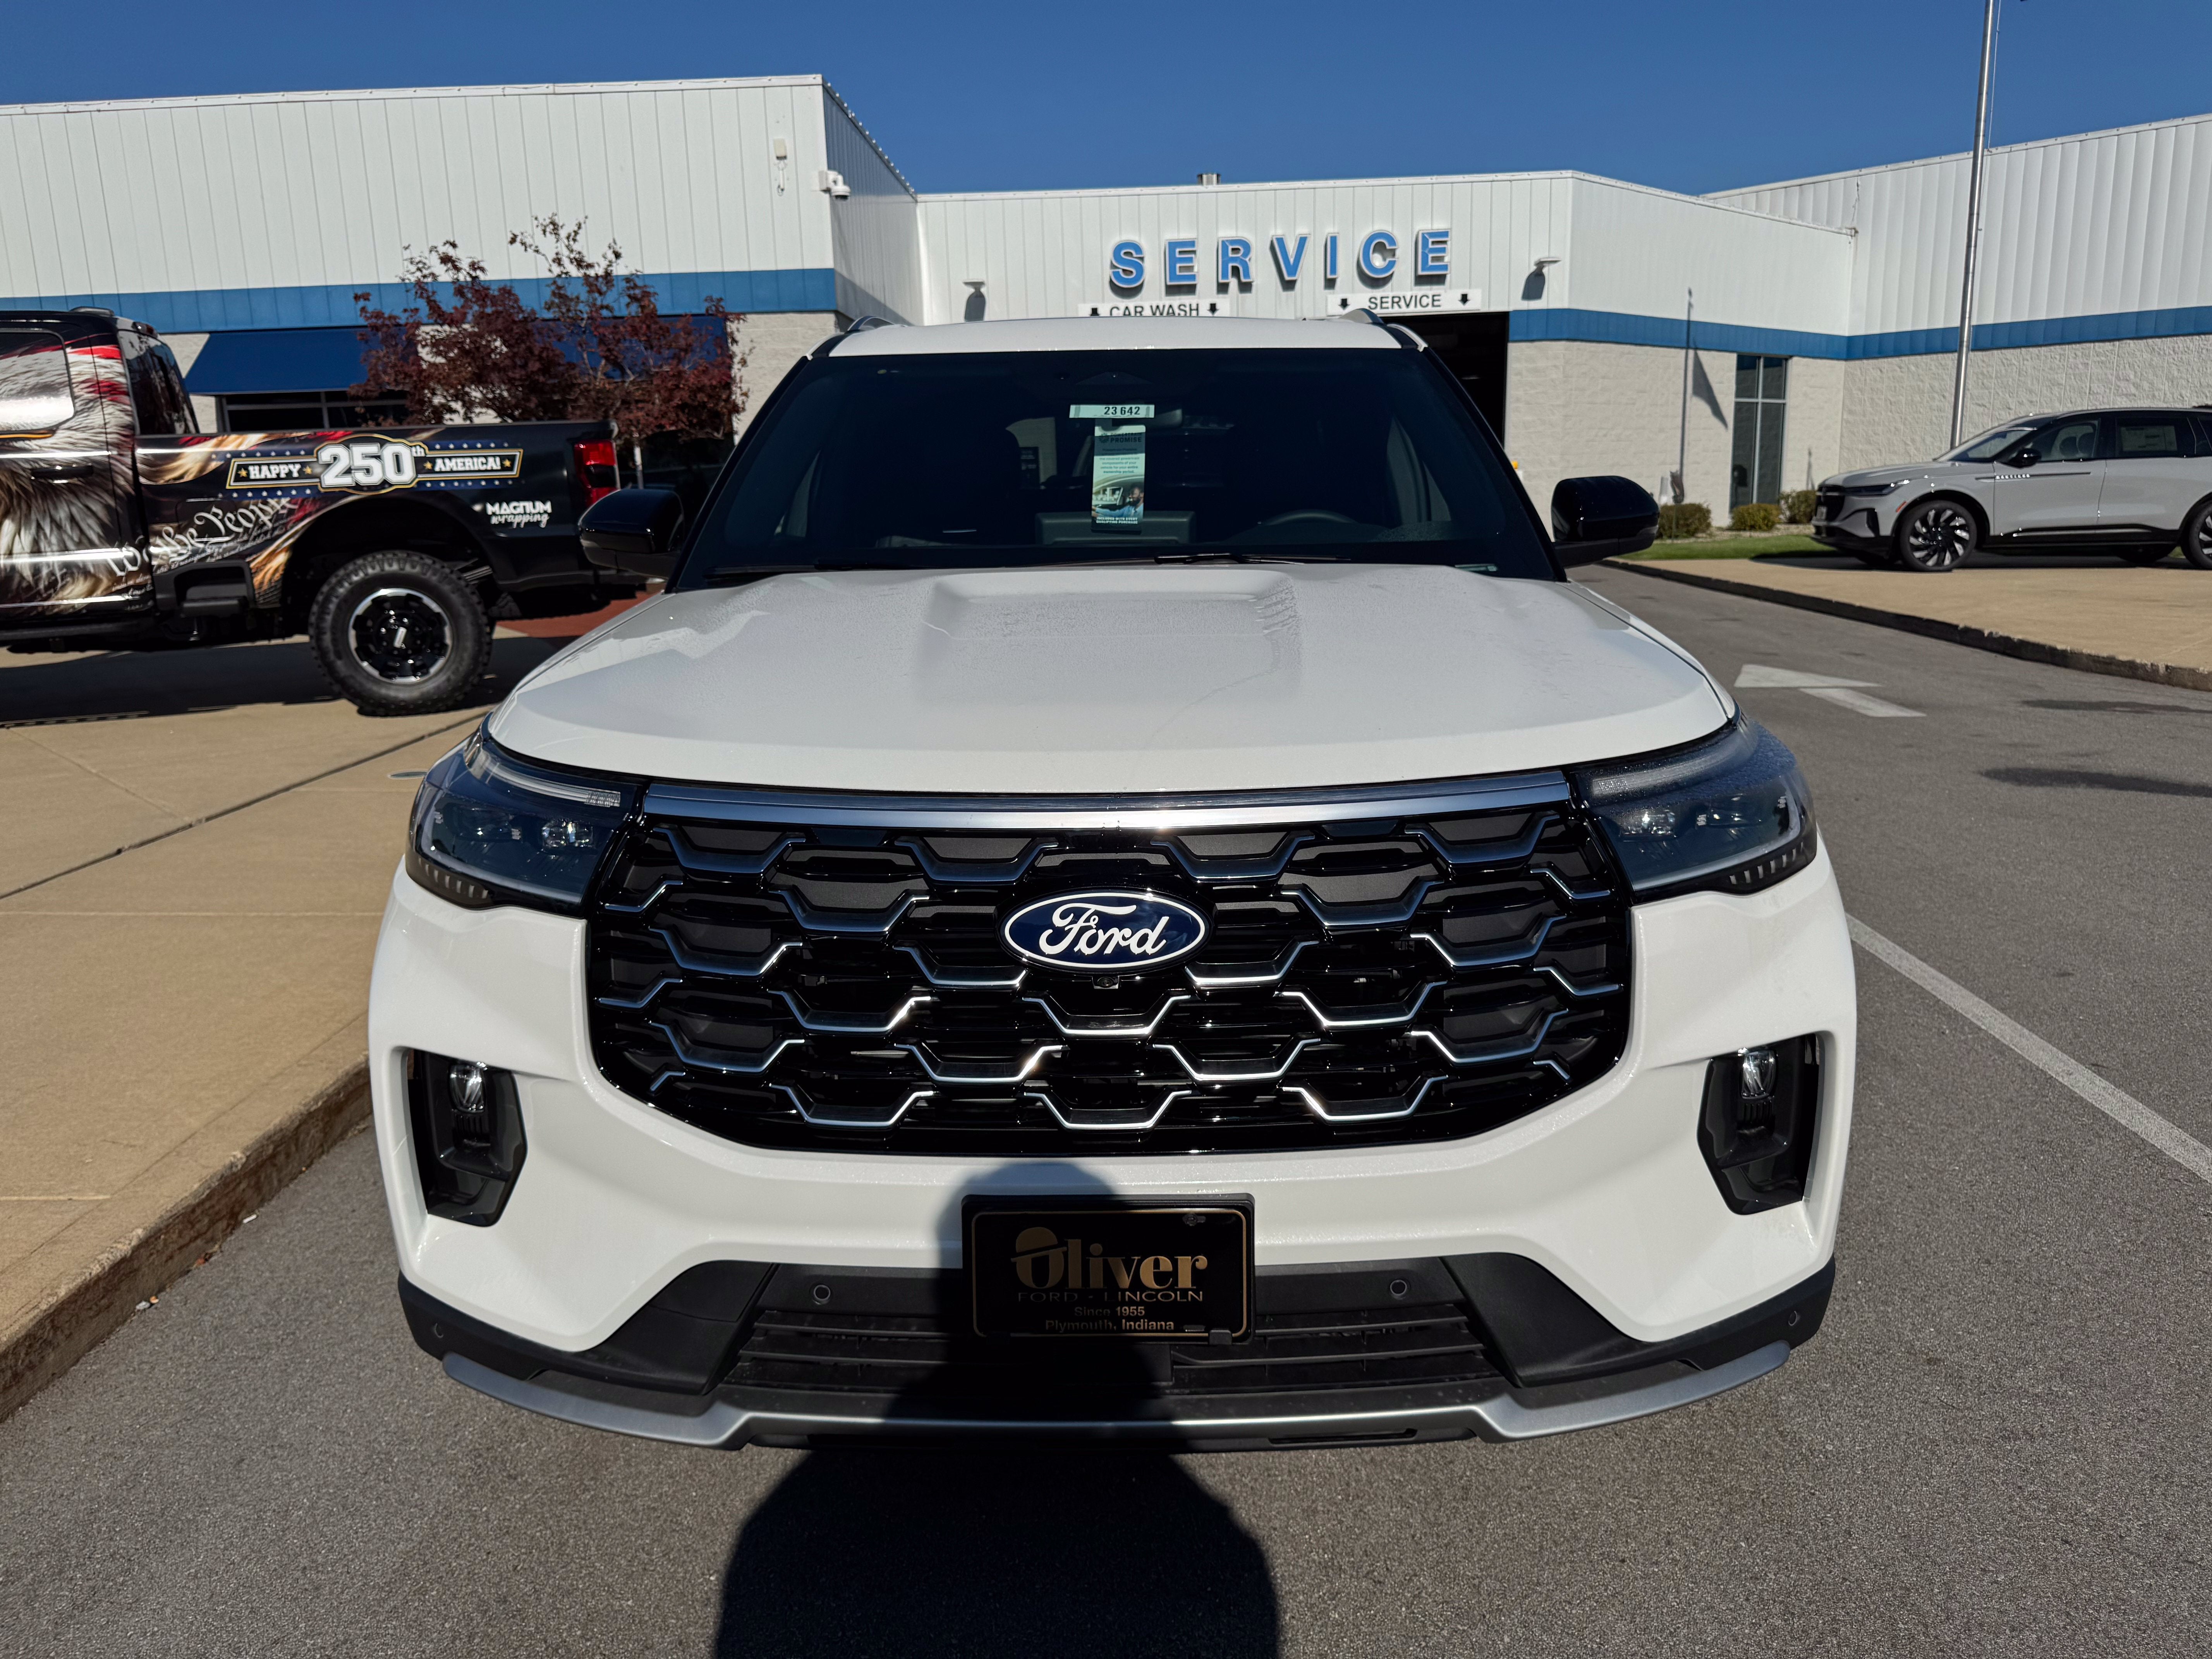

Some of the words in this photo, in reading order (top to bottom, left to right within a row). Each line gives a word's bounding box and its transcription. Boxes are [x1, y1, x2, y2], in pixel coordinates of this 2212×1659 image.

[1110, 229, 1451, 288] SERVICE
[1368, 294, 1441, 309] SERVICE
[1110, 306, 1144, 316] CAR
[1150, 303, 1199, 316] WASH
[248, 463, 302, 479] HAPPY
[434, 456, 501, 472] AMERICA!
[490, 513, 550, 528] wrapping
[1039, 903, 1170, 955] Ford
[1011, 1226, 1208, 1289] Oliver
[1018, 1292, 1078, 1302] FORD
[1104, 1291, 1202, 1302] LINCOLN
[1074, 1307, 1111, 1316] Since
[1116, 1307, 1145, 1316] 1955
[1046, 1319, 1117, 1333] Plymouth,
[1122, 1319, 1174, 1331] Indiana
